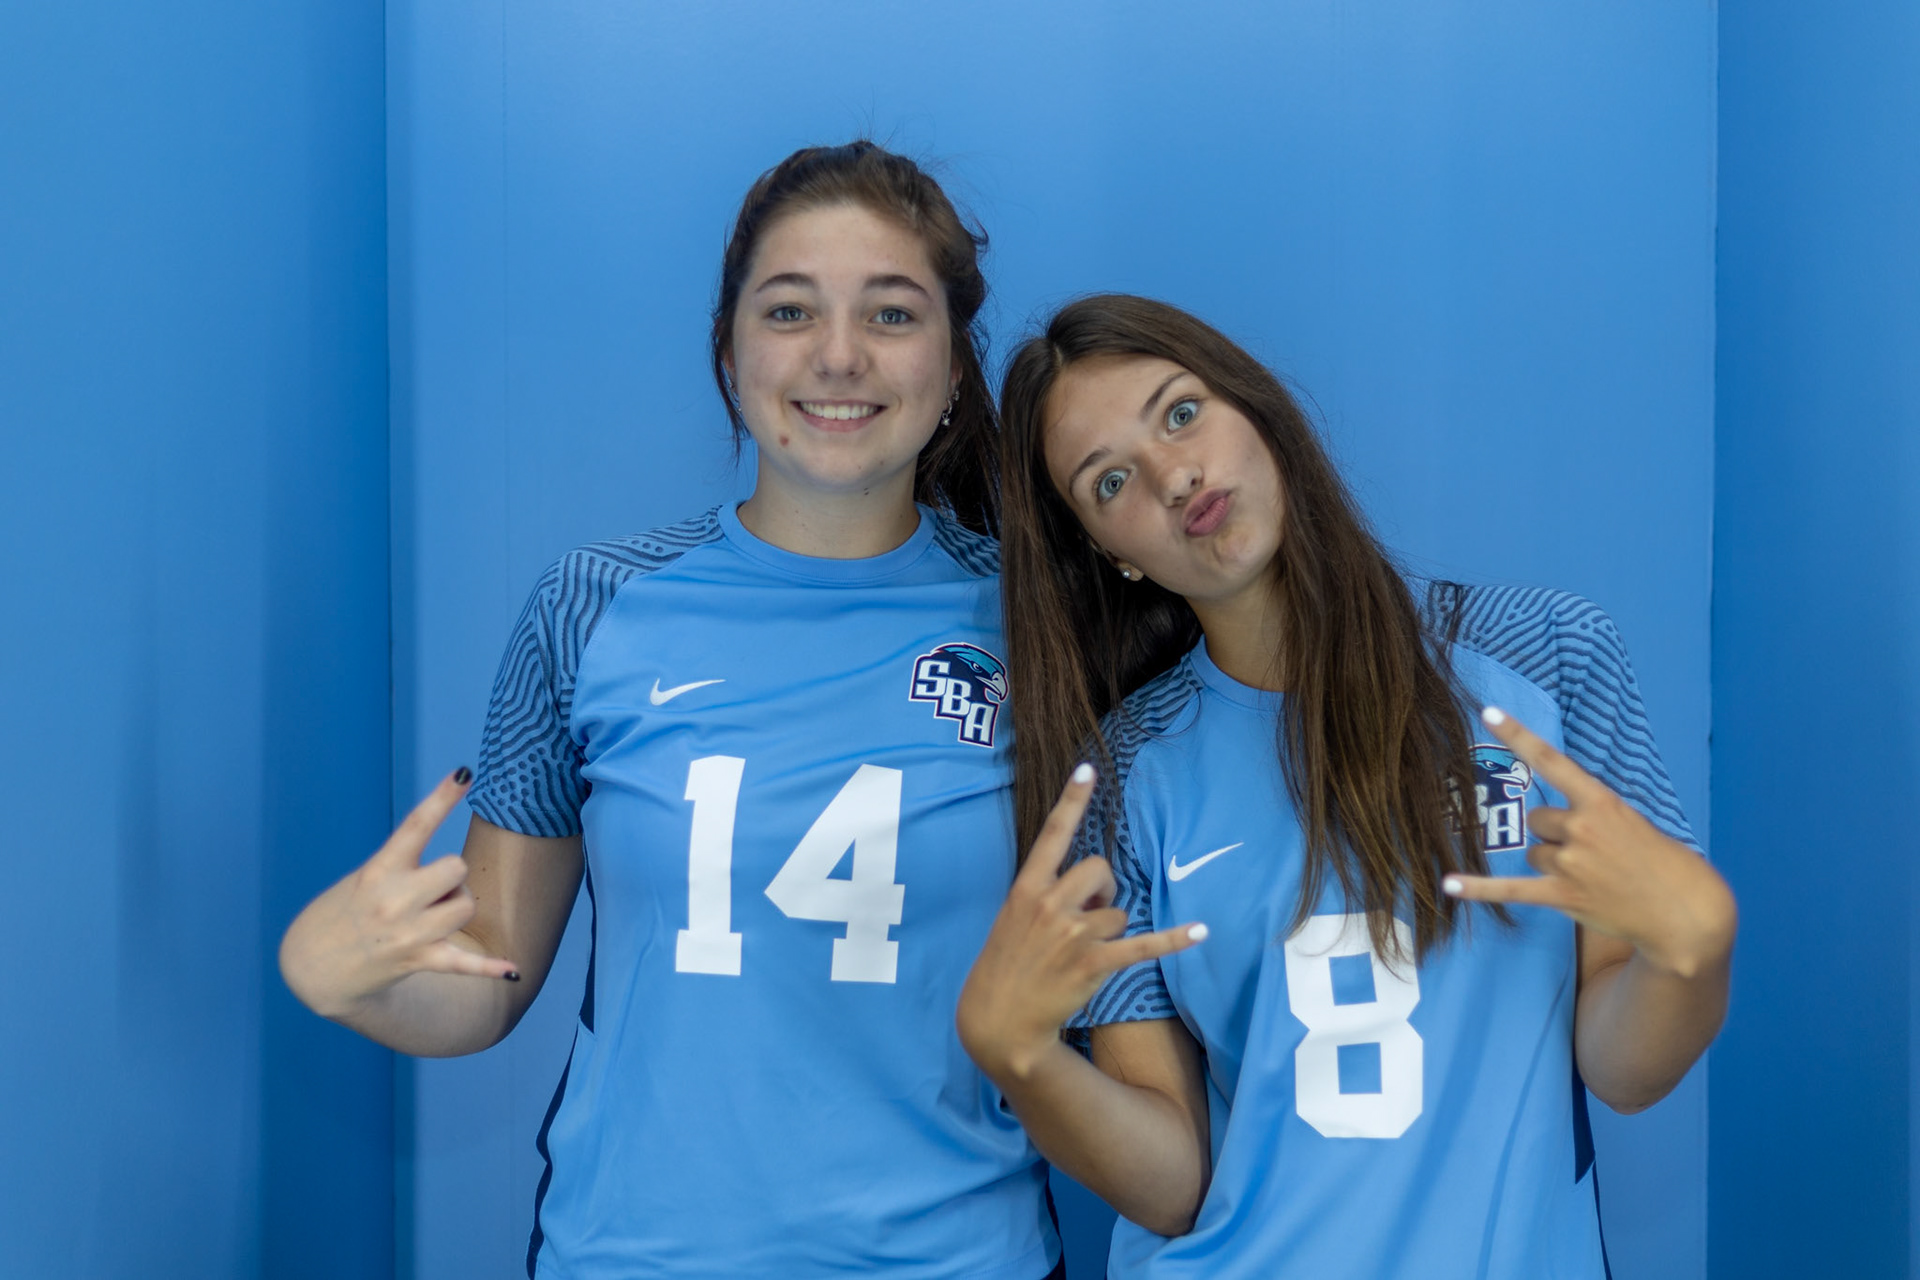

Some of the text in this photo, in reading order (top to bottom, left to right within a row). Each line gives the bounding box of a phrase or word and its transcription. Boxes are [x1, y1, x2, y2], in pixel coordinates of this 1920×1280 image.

[915, 660, 996, 743] SBA
[675, 755, 905, 984] 14
[1284, 910, 1424, 1139] 8
